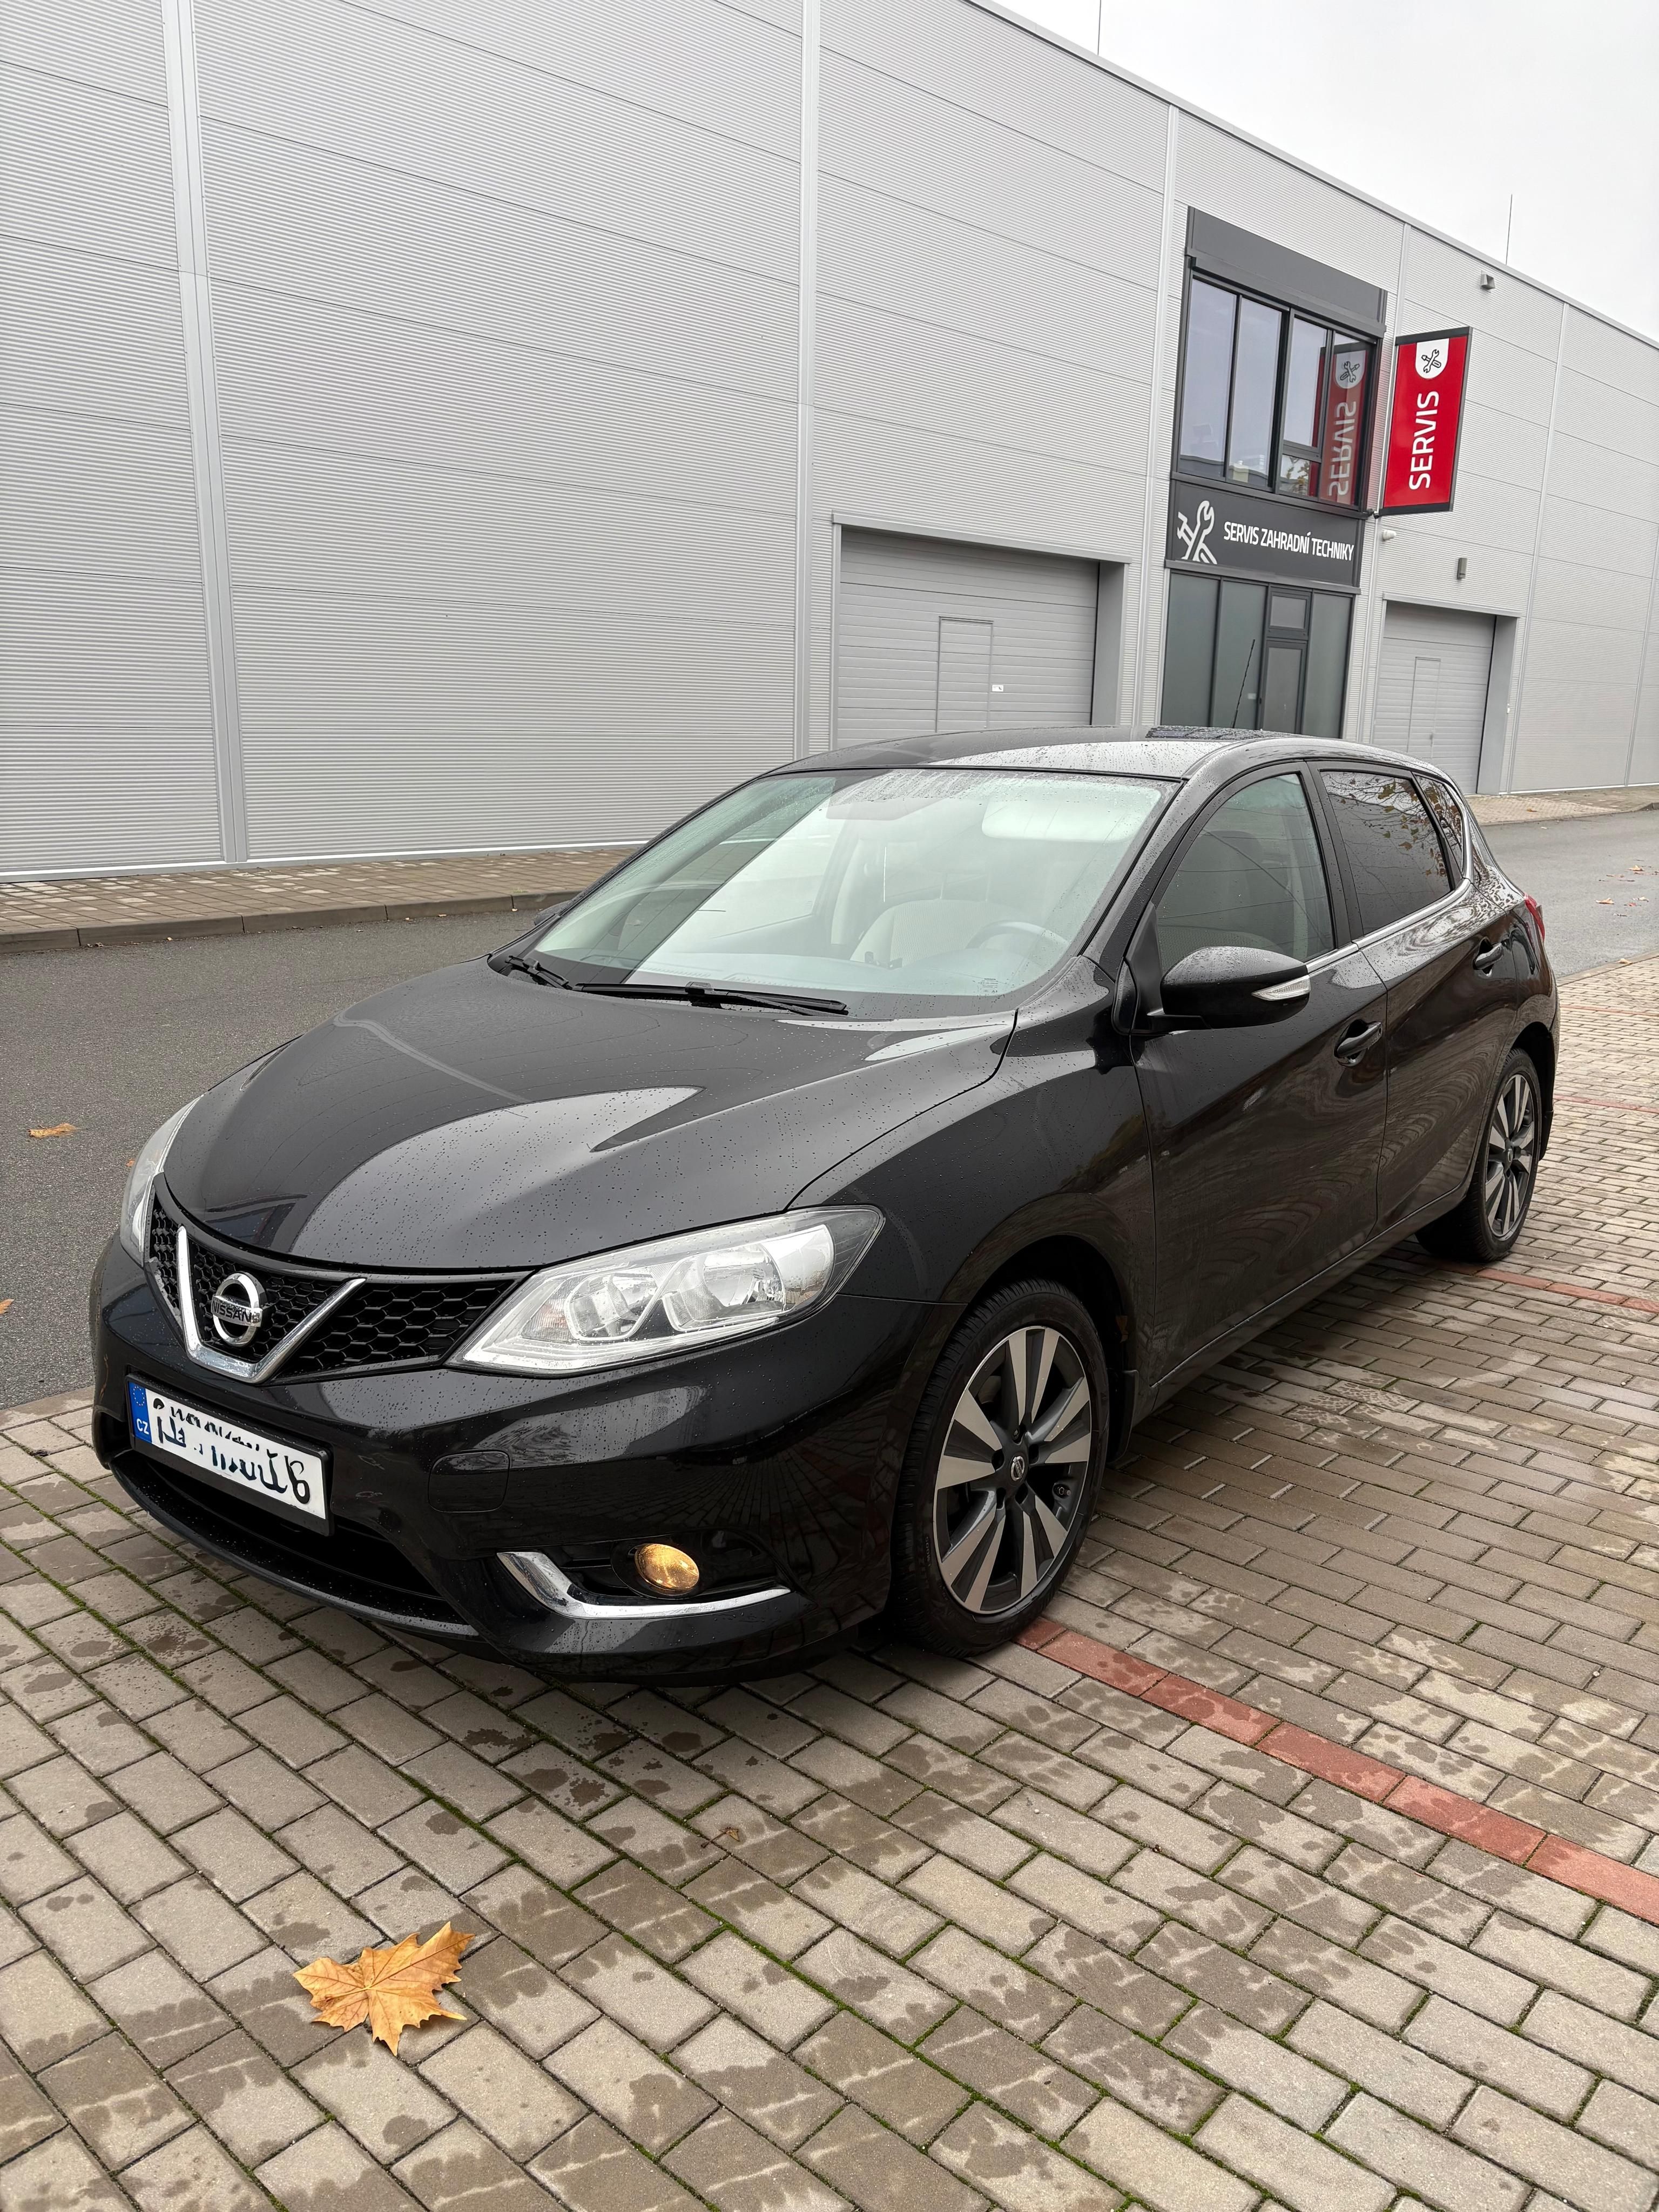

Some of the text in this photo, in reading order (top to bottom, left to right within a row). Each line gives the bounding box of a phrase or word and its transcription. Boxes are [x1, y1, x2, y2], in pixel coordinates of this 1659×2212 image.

[1408, 391, 1439, 490] SERVIS
[1223, 521, 1354, 561] SERVIS ZAHRADNÍ TECHNIKY
[211, 1298, 252, 1323] NISSAN
[136, 1418, 150, 1435] CZ
